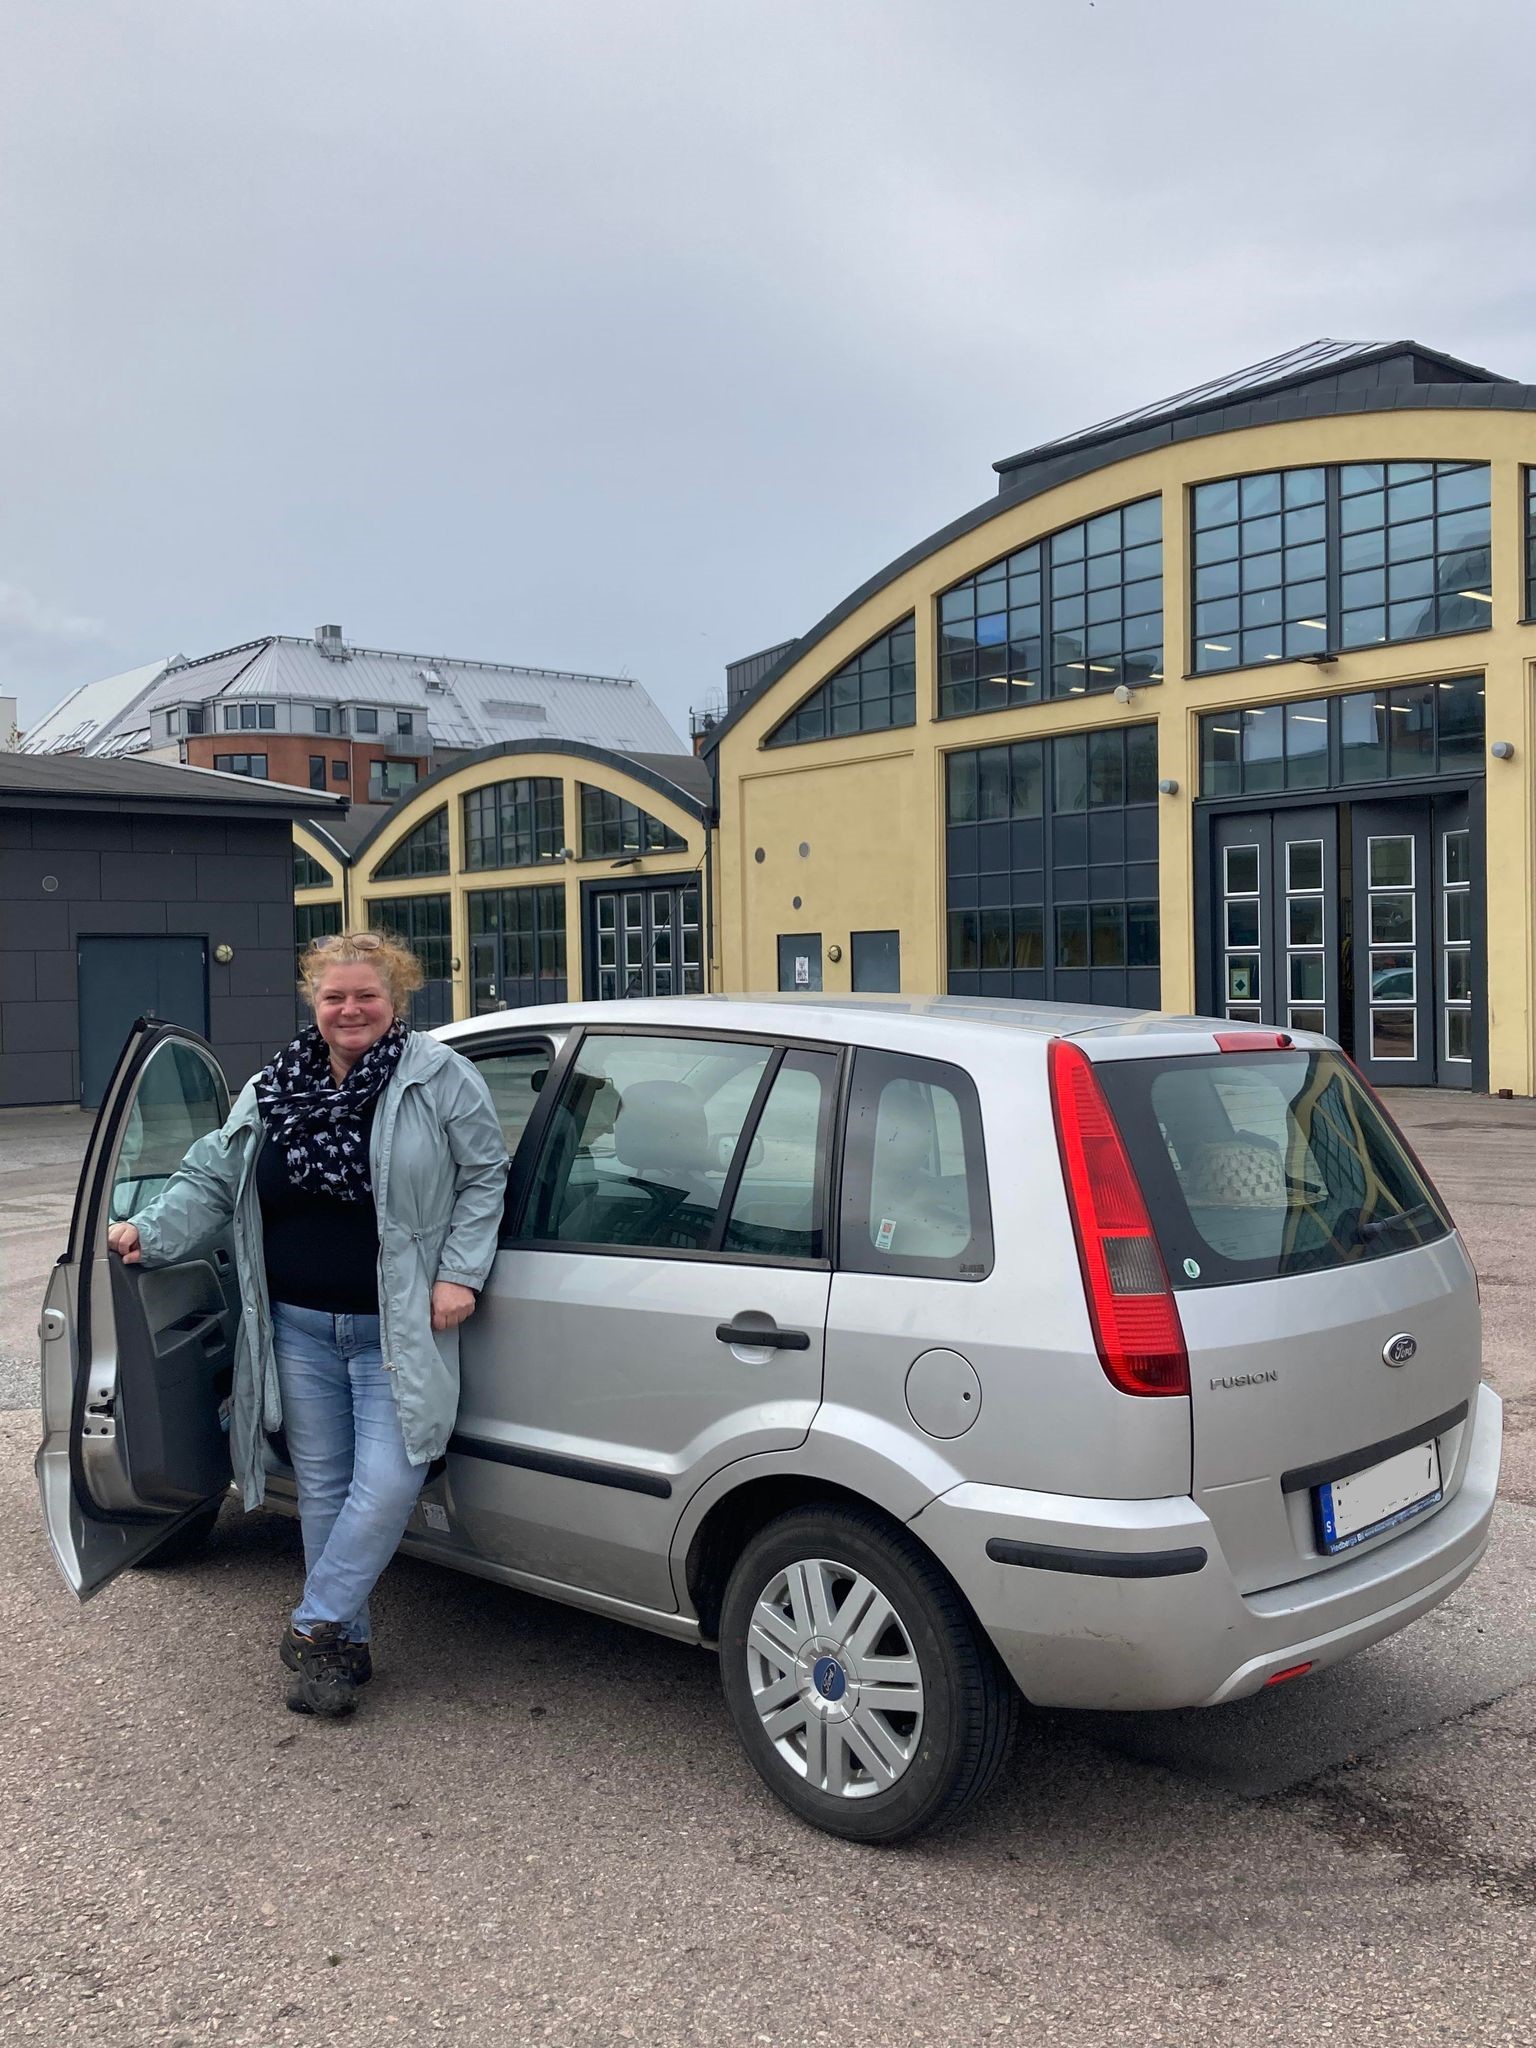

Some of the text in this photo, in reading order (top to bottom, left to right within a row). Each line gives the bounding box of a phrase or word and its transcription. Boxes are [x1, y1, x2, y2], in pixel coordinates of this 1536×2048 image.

[1394, 1340, 1413, 1360] Ford
[1209, 1369, 1279, 1391] FUSION
[1326, 1520, 1332, 1533] S
[822, 1666, 835, 1693] Ford
